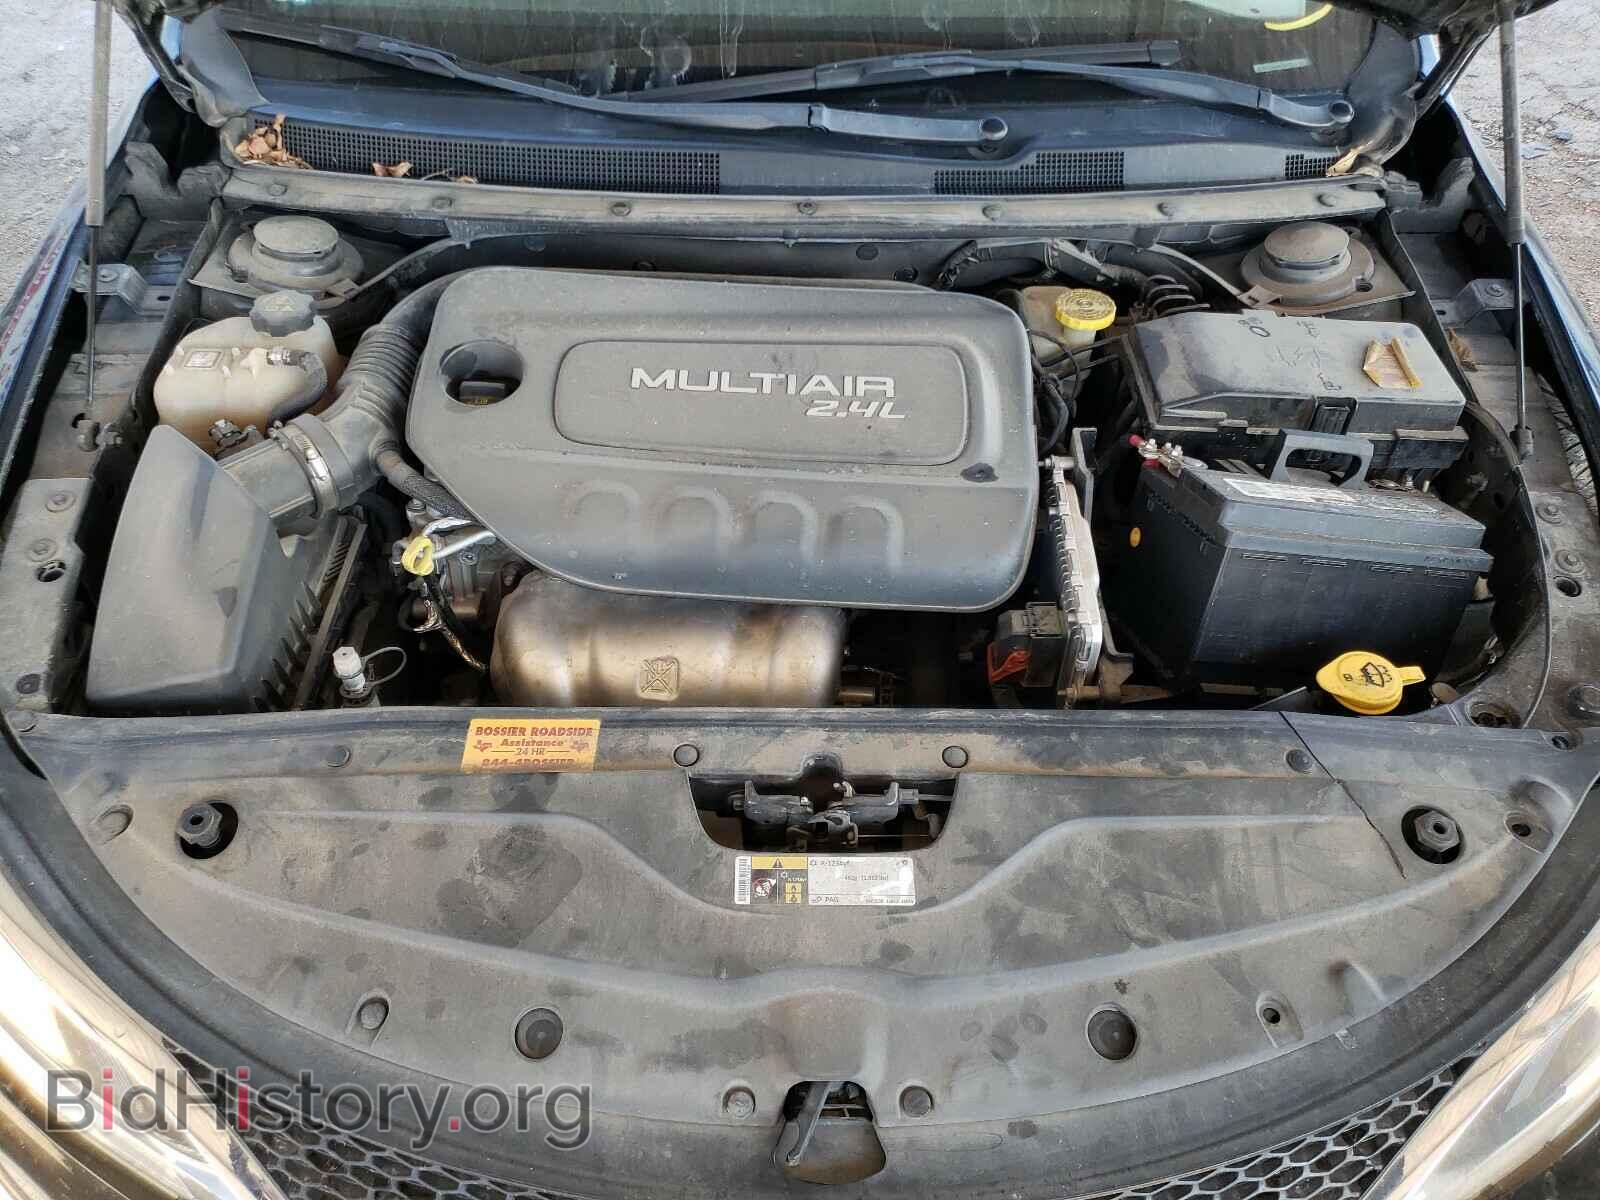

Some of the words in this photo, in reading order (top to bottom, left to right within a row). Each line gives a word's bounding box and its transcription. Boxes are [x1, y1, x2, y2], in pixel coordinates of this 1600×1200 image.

[631, 367, 895, 398] MULTIAIR
[805, 400, 905, 419] 2.4L
[475, 726, 527, 737] BOSSIER
[530, 727, 594, 737] ROADSIDE
[500, 738, 564, 747] Assistance
[514, 747, 528, 756] 24
[531, 747, 545, 756] HR
